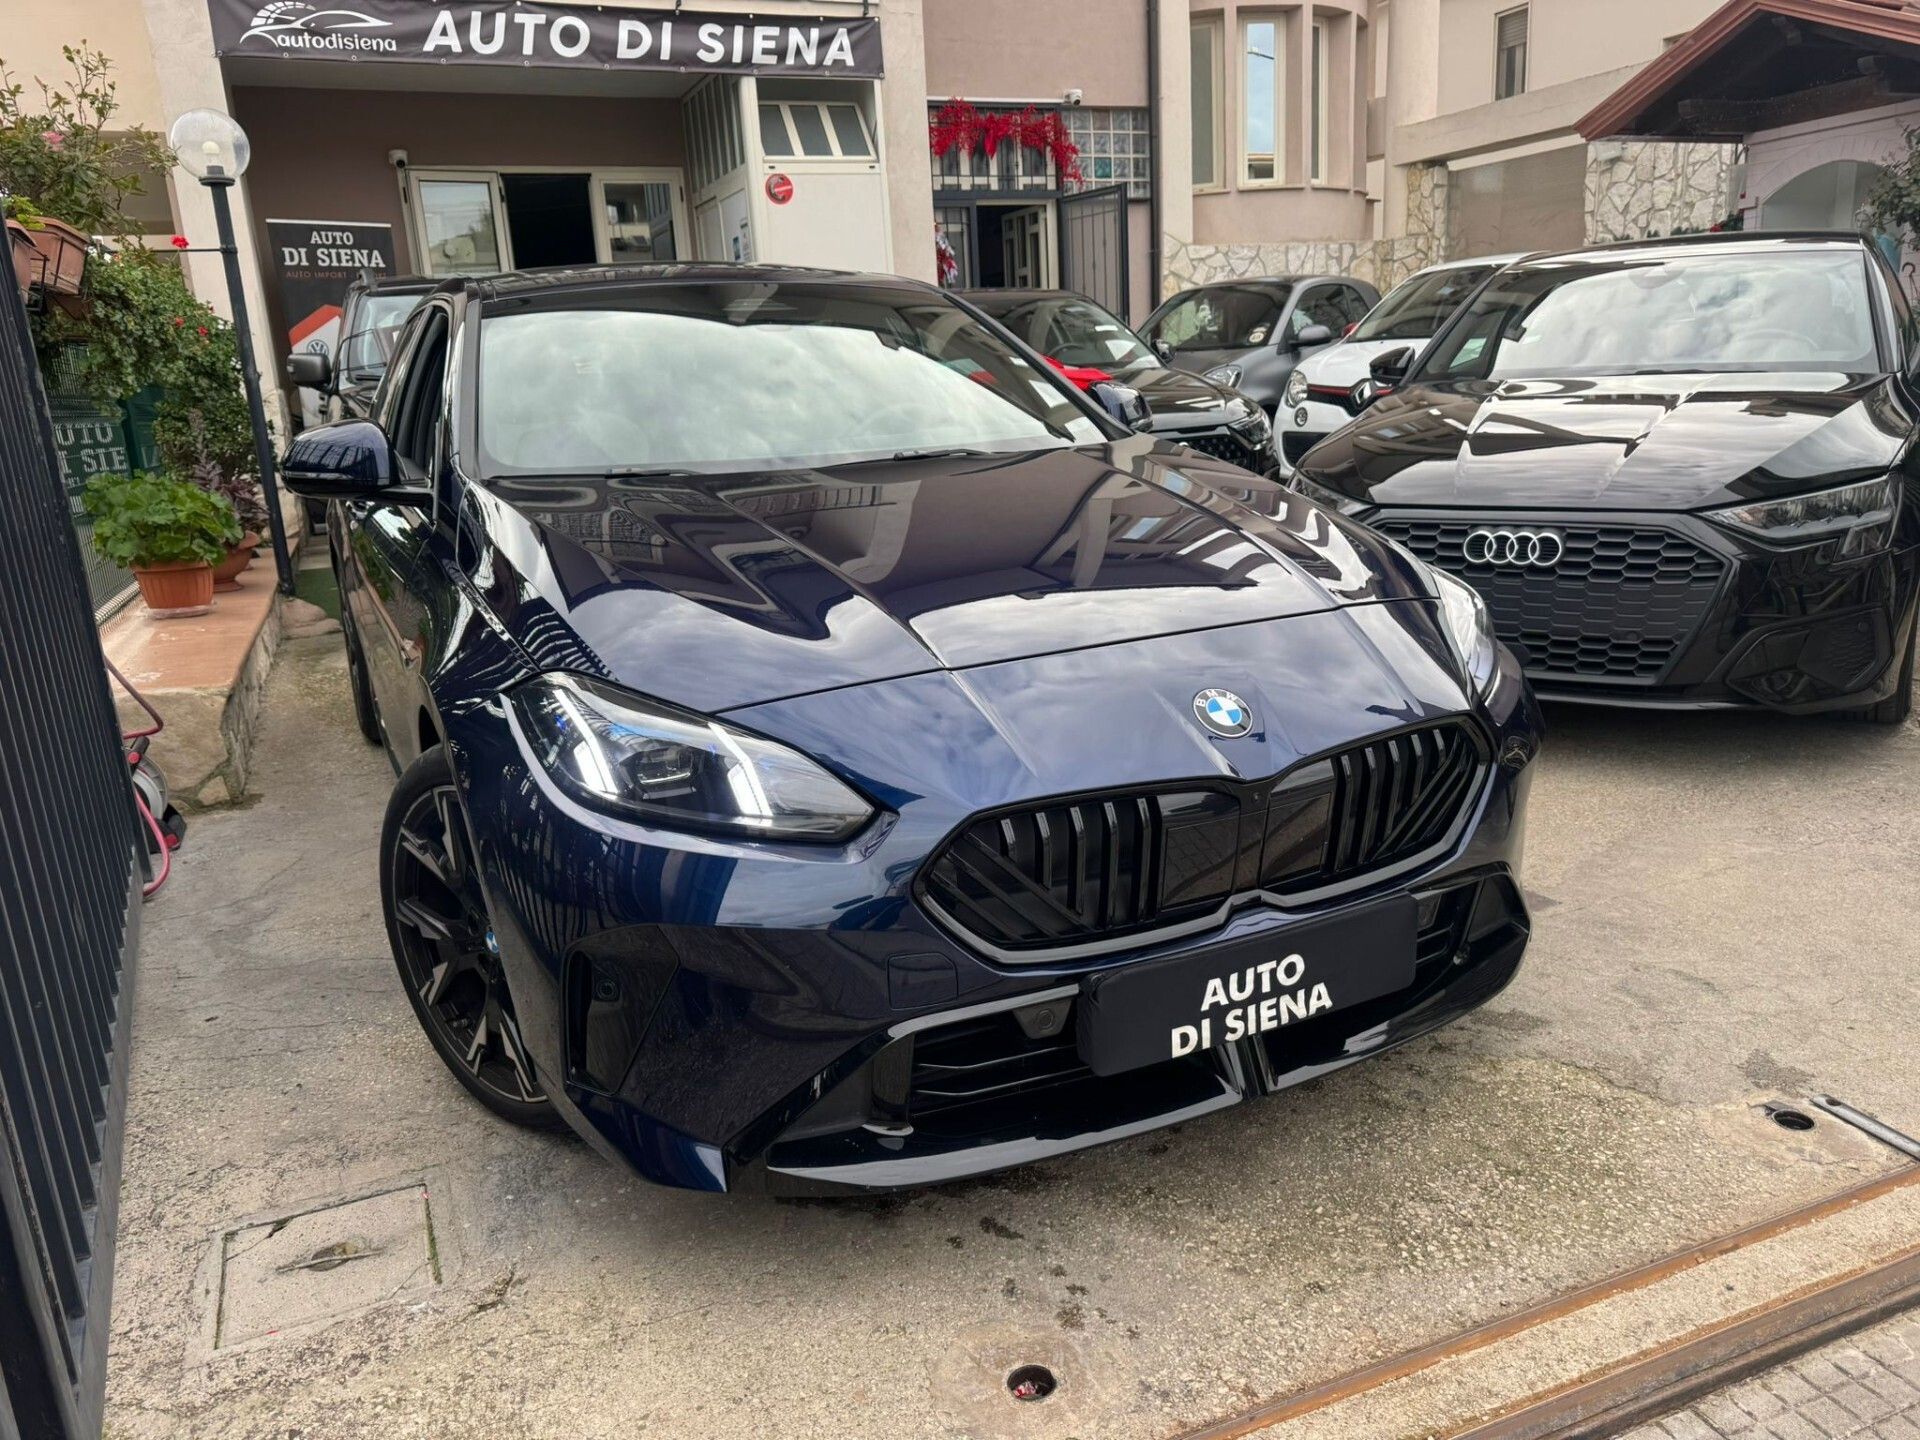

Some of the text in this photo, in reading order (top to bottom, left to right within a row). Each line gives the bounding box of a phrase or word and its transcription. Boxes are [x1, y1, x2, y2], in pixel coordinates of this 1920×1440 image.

[277, 31, 397, 52] autodisiena
[422, 11, 855, 67] AUTO DI SIENA
[310, 230, 354, 245] AUTO
[282, 247, 386, 268] DI SIENA
[286, 271, 311, 279] AUTO
[314, 271, 347, 279] IMPORT
[54, 422, 114, 446] UTO
[57, 446, 127, 474] I SIE
[1195, 689, 1240, 708] BMW
[1200, 953, 1306, 1011] AUTO
[1170, 982, 1334, 1059] DI SIENA
